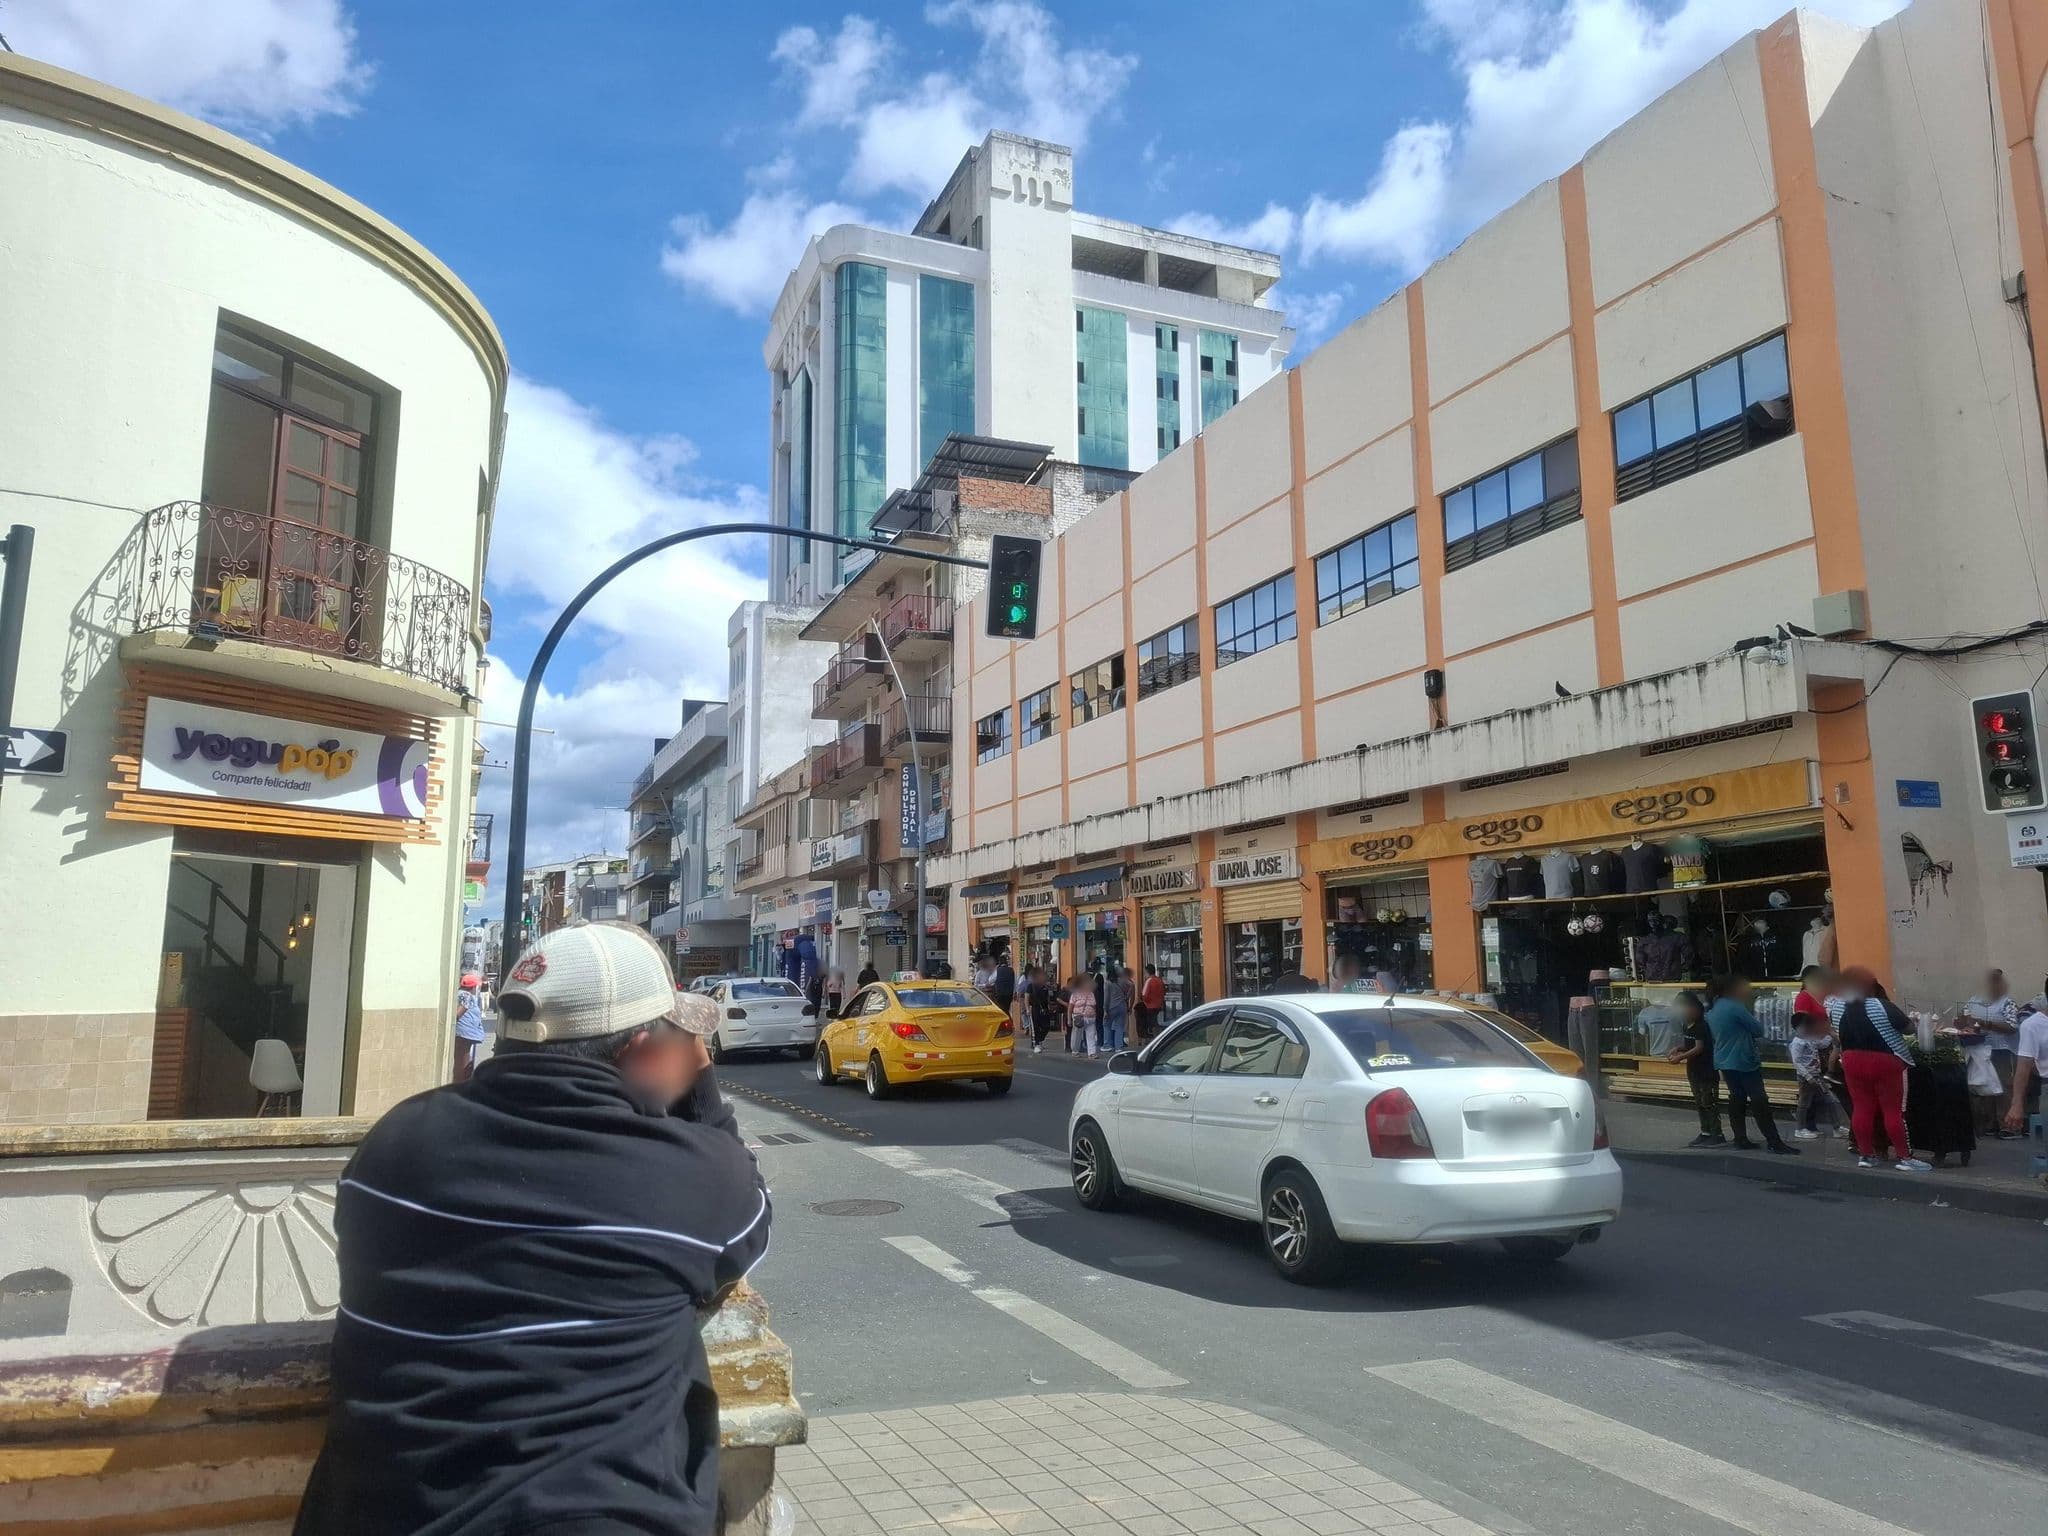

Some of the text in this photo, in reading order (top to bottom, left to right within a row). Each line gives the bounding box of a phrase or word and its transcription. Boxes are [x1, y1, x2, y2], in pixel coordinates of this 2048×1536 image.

[173, 727, 353, 780] yogupop
[212, 770, 311, 792] Comparte felicidad!!
[1611, 786, 1715, 825] eggo
[1462, 814, 1544, 847] eggo
[1350, 834, 1413, 861] eggo
[1153, 870, 1183, 890] JOYAS
[1217, 856, 1282, 881] MARIA JOSE
[1356, 979, 1375, 987] TAXI
